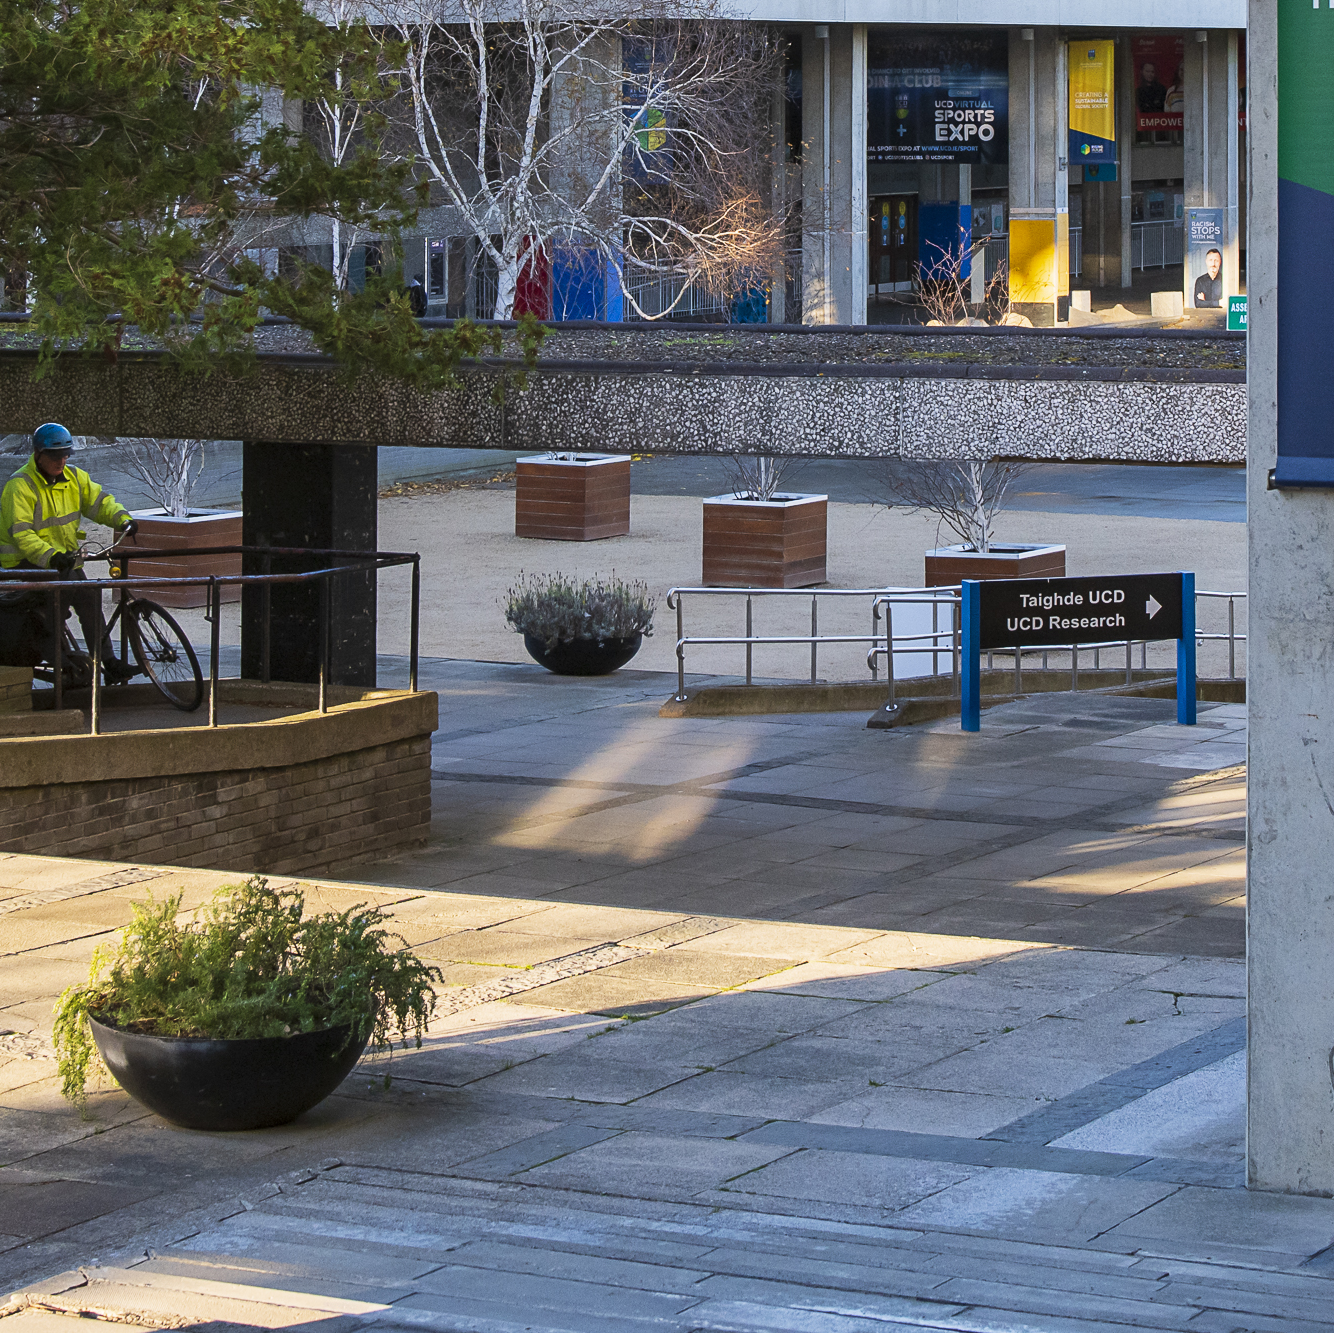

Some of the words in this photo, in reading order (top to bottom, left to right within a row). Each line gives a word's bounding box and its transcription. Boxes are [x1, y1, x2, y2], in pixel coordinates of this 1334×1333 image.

[904, 75, 942, 88] CLUB
[934, 110, 995, 122] SPORTS
[1140, 118, 1184, 127] EMPOWE
[935, 123, 995, 141] EXPO
[1191, 226, 1221, 235] STOPS
[1231, 303, 1247, 312] ASSE
[1020, 593, 1083, 609] Taighde
[1089, 590, 1125, 604] UCD
[1007, 617, 1043, 631] UCD
[1049, 614, 1125, 630] Research
